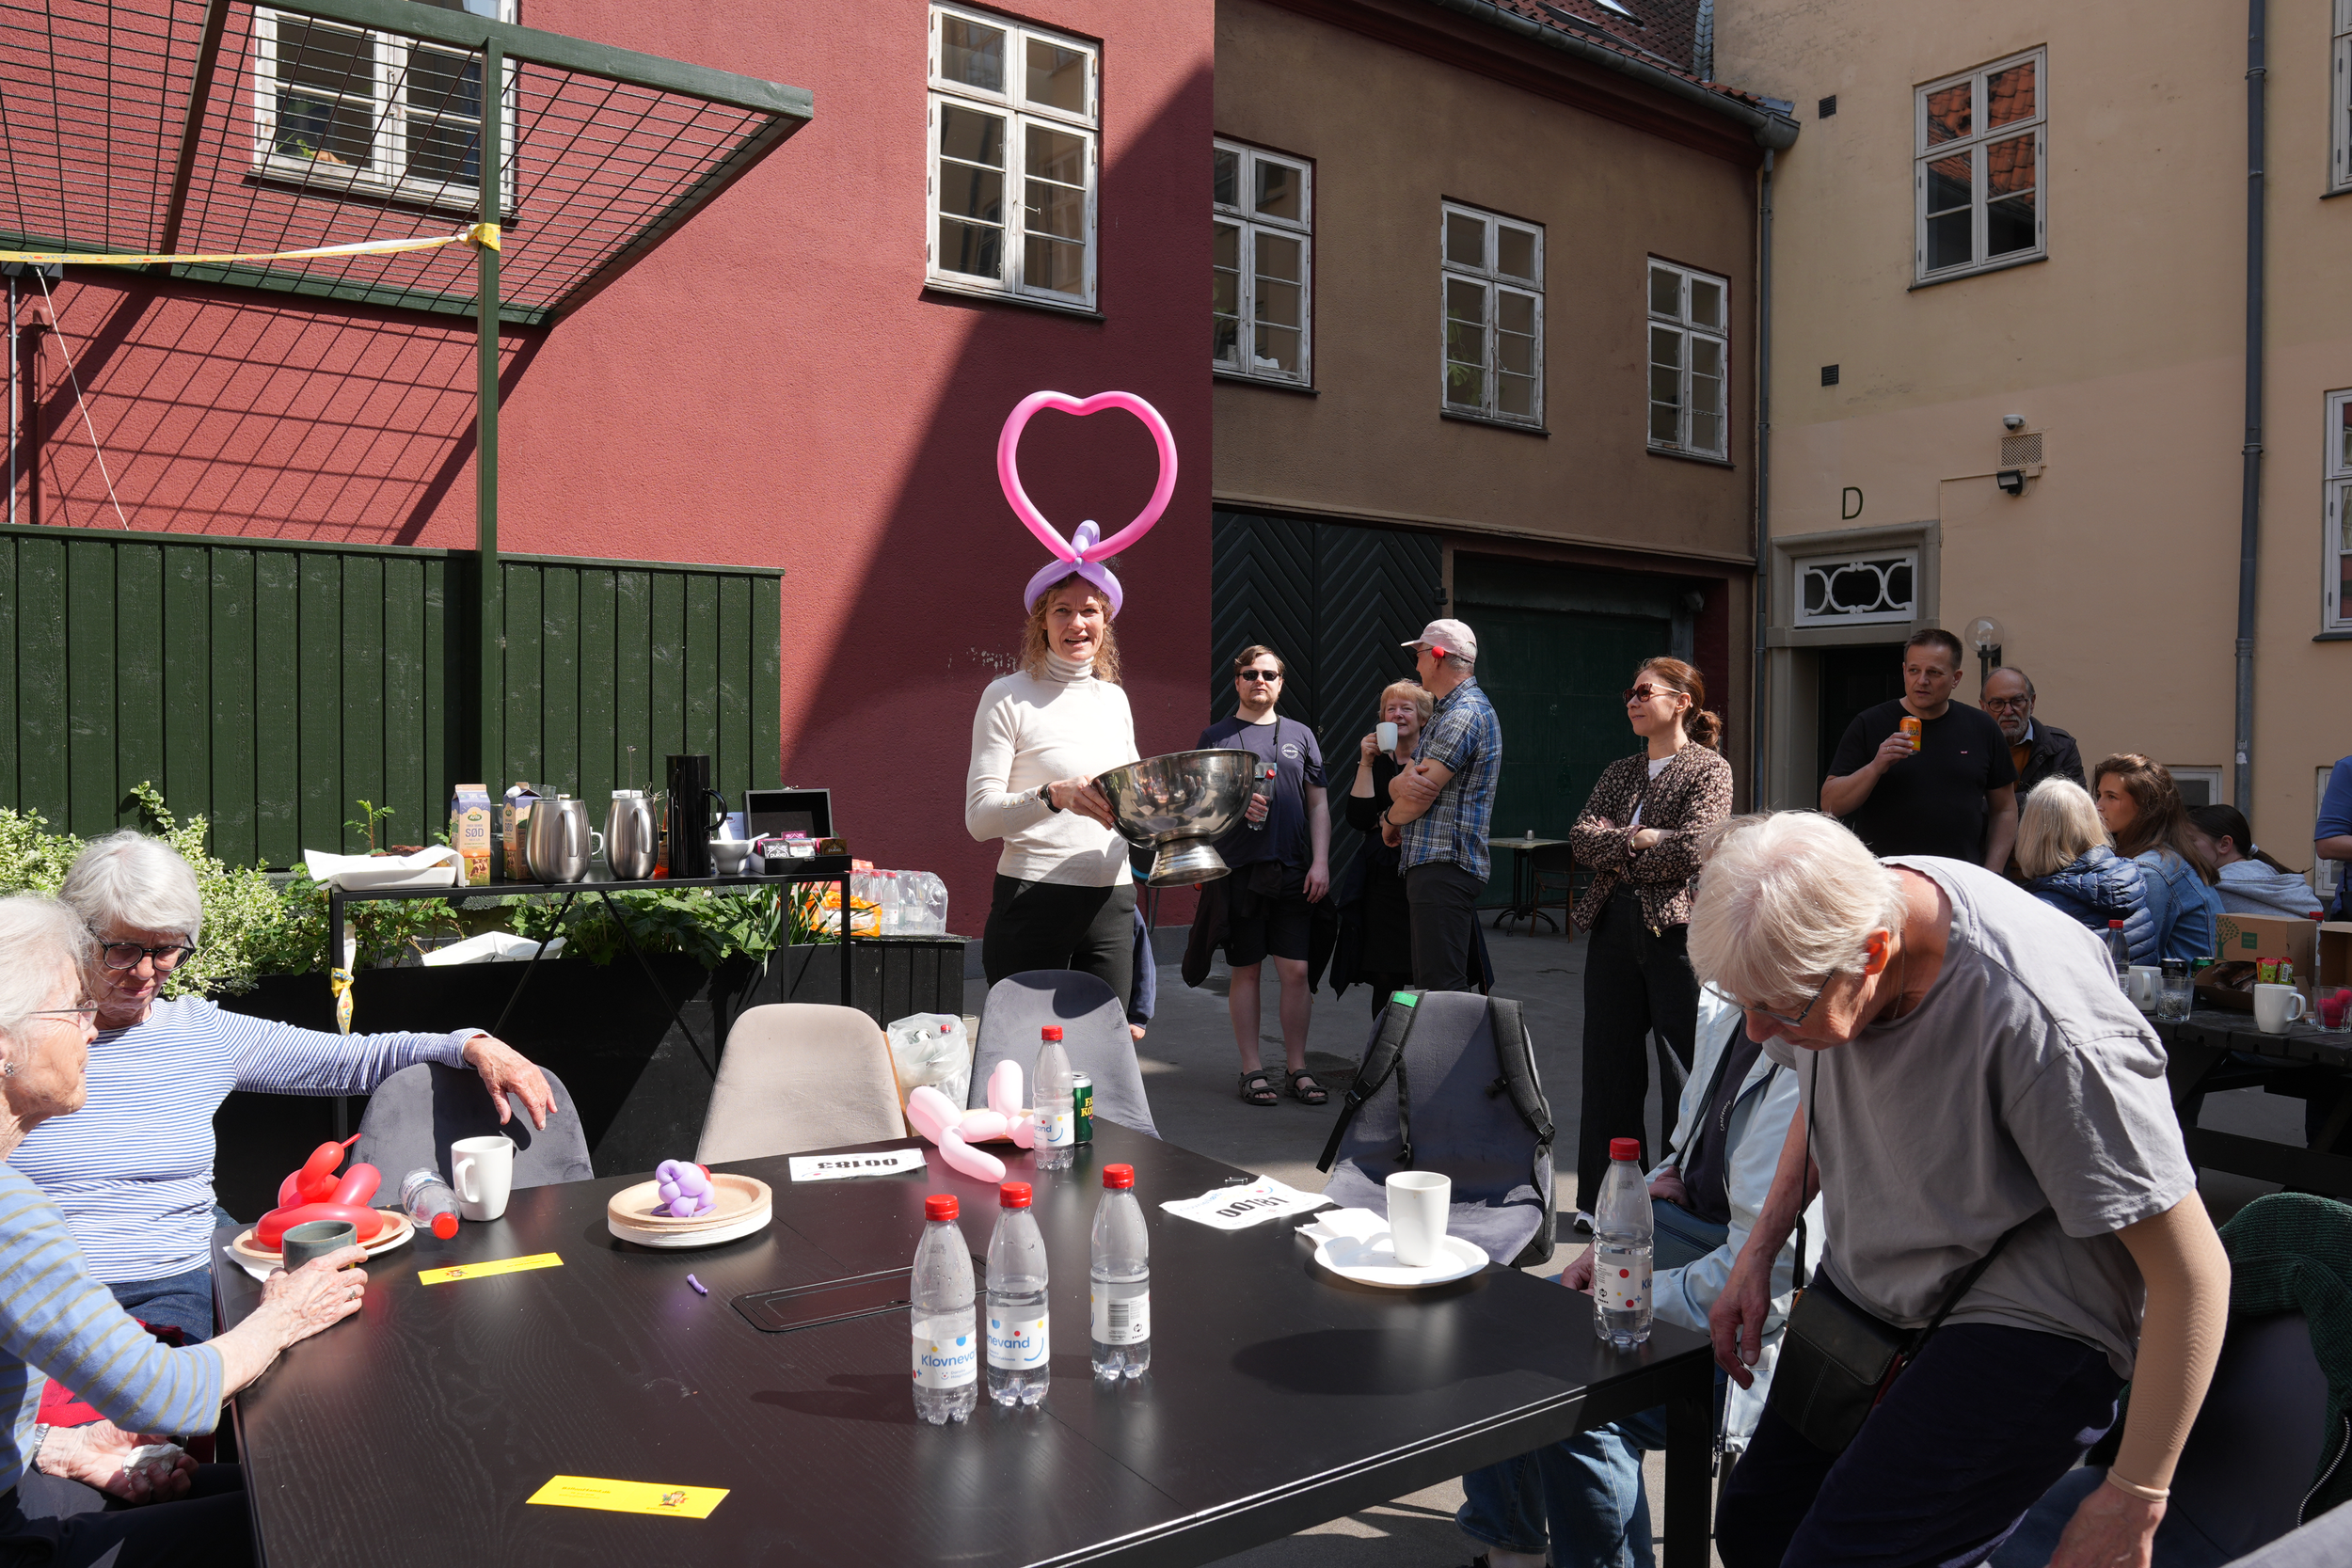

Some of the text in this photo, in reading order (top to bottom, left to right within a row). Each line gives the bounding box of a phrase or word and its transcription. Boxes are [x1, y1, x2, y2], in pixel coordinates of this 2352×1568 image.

[1841, 486, 1864, 520] D
[465, 828, 485, 838] SØD
[817, 1158, 898, 1169] 00183
[1216, 1196, 1290, 1217] 00181
